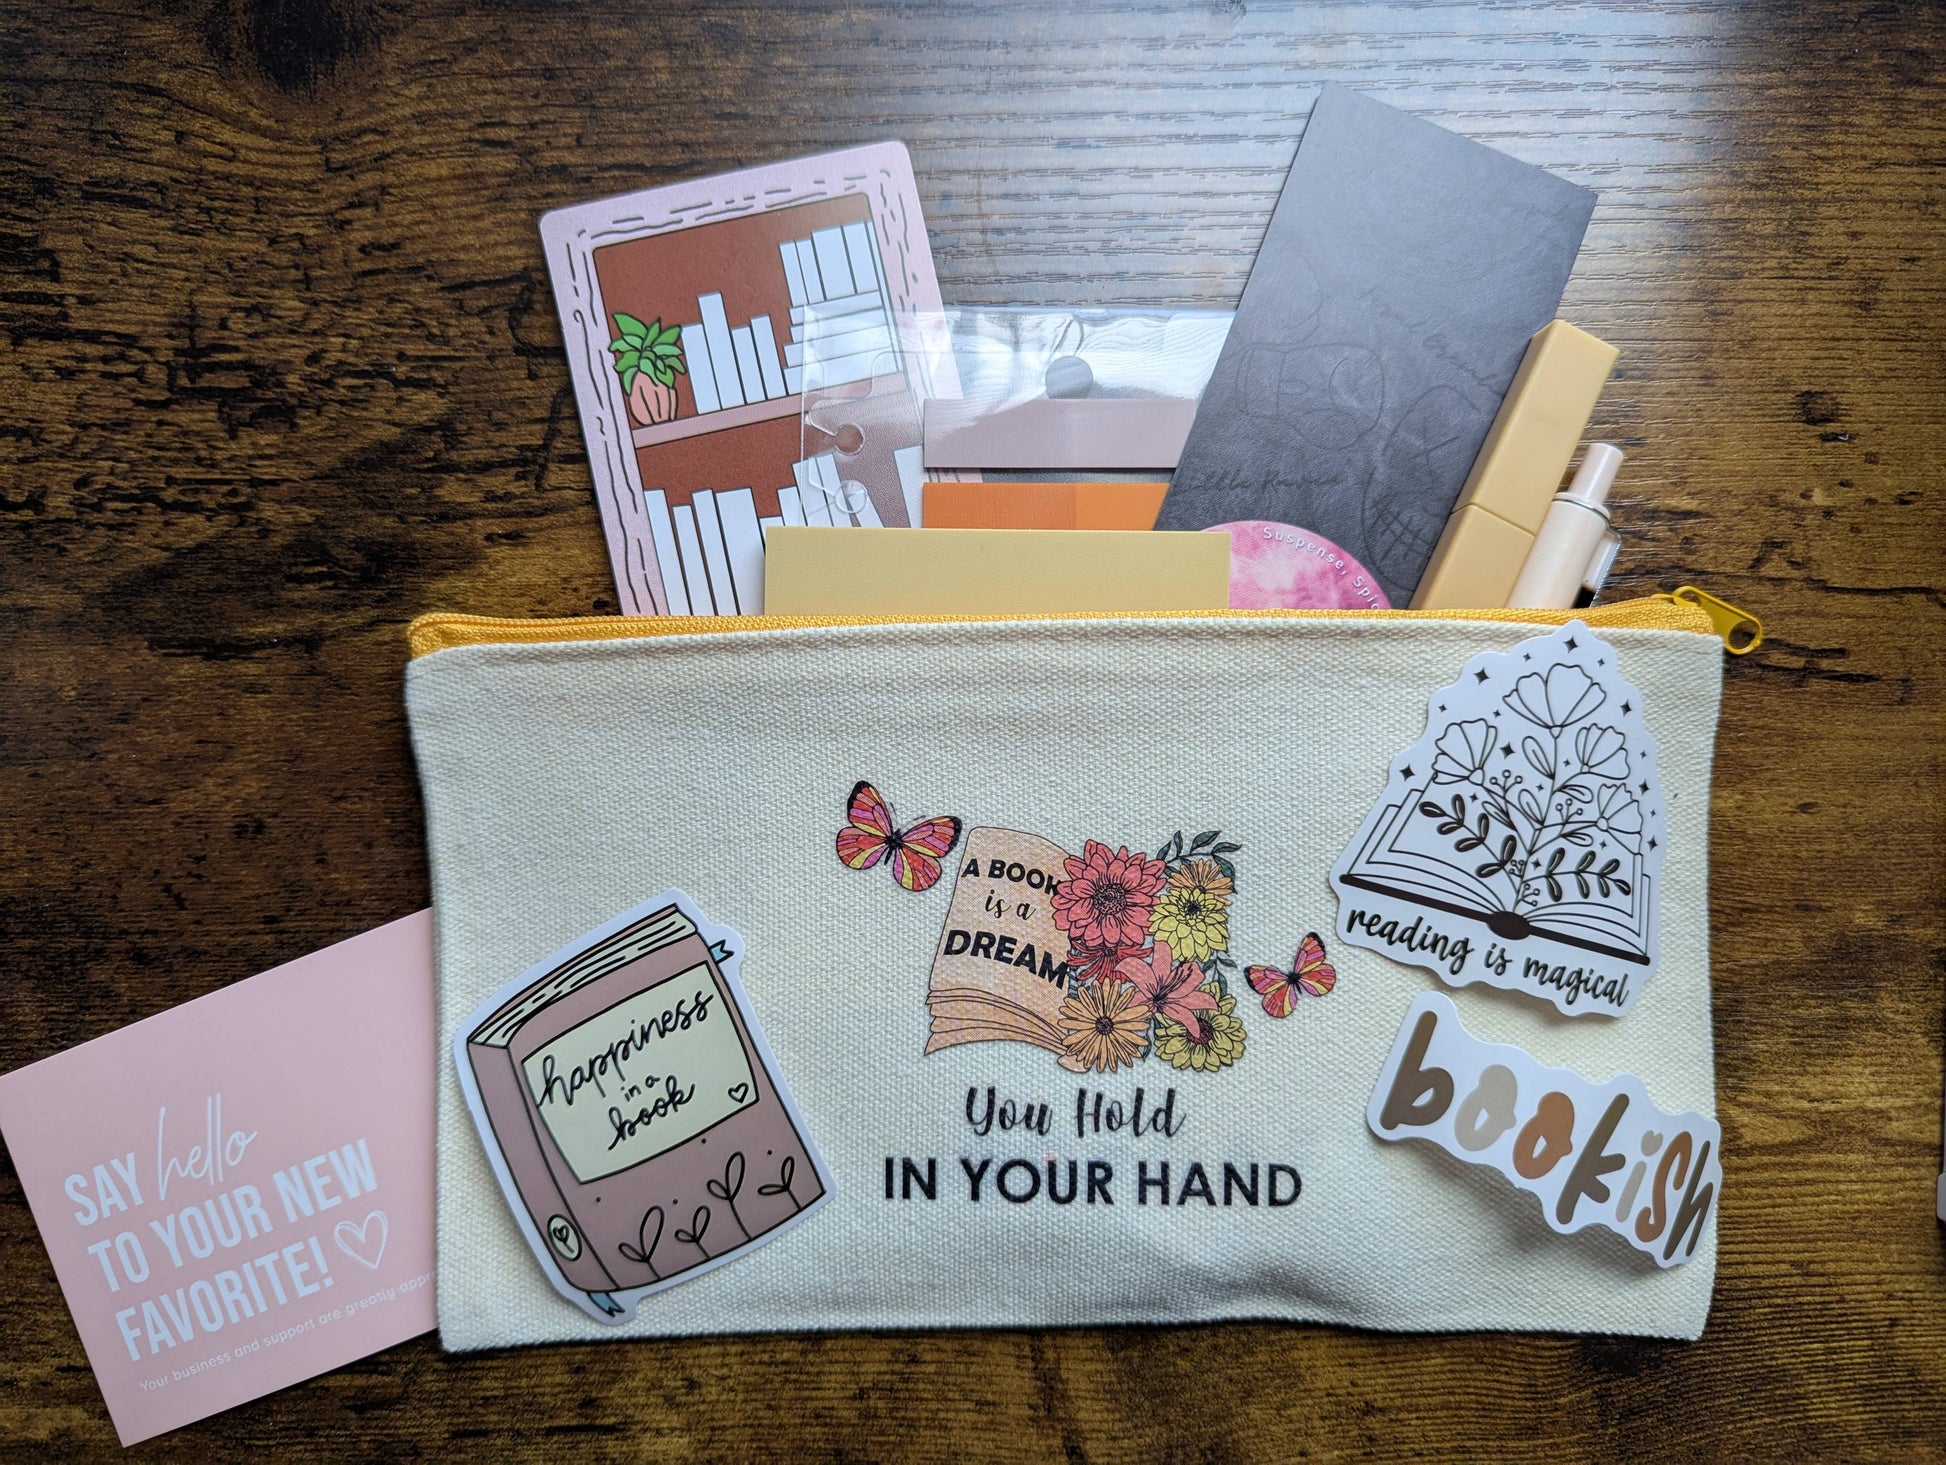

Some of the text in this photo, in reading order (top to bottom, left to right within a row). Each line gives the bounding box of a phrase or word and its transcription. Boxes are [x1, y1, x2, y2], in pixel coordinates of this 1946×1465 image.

[1262, 526, 1348, 576] Suspense,
[961, 858, 980, 878] A
[985, 888, 1036, 921] is a
[943, 929, 1069, 990] DREAM
[1345, 908, 1630, 1008] reading is magical
[536, 990, 714, 1109] happiness
[608, 1075, 695, 1150] book
[620, 1075, 660, 1102] in a
[965, 1086, 1187, 1138] You Hold
[63, 1092, 259, 1226] SAY hello
[1379, 1010, 1714, 1261] bookish
[86, 1137, 378, 1293] TO YOUR NEW
[884, 1156, 1302, 1207] IN YOUR HAND
[114, 1235, 335, 1362] FAVORITE!
[139, 1270, 436, 1392] Your business and support are greatly appr
